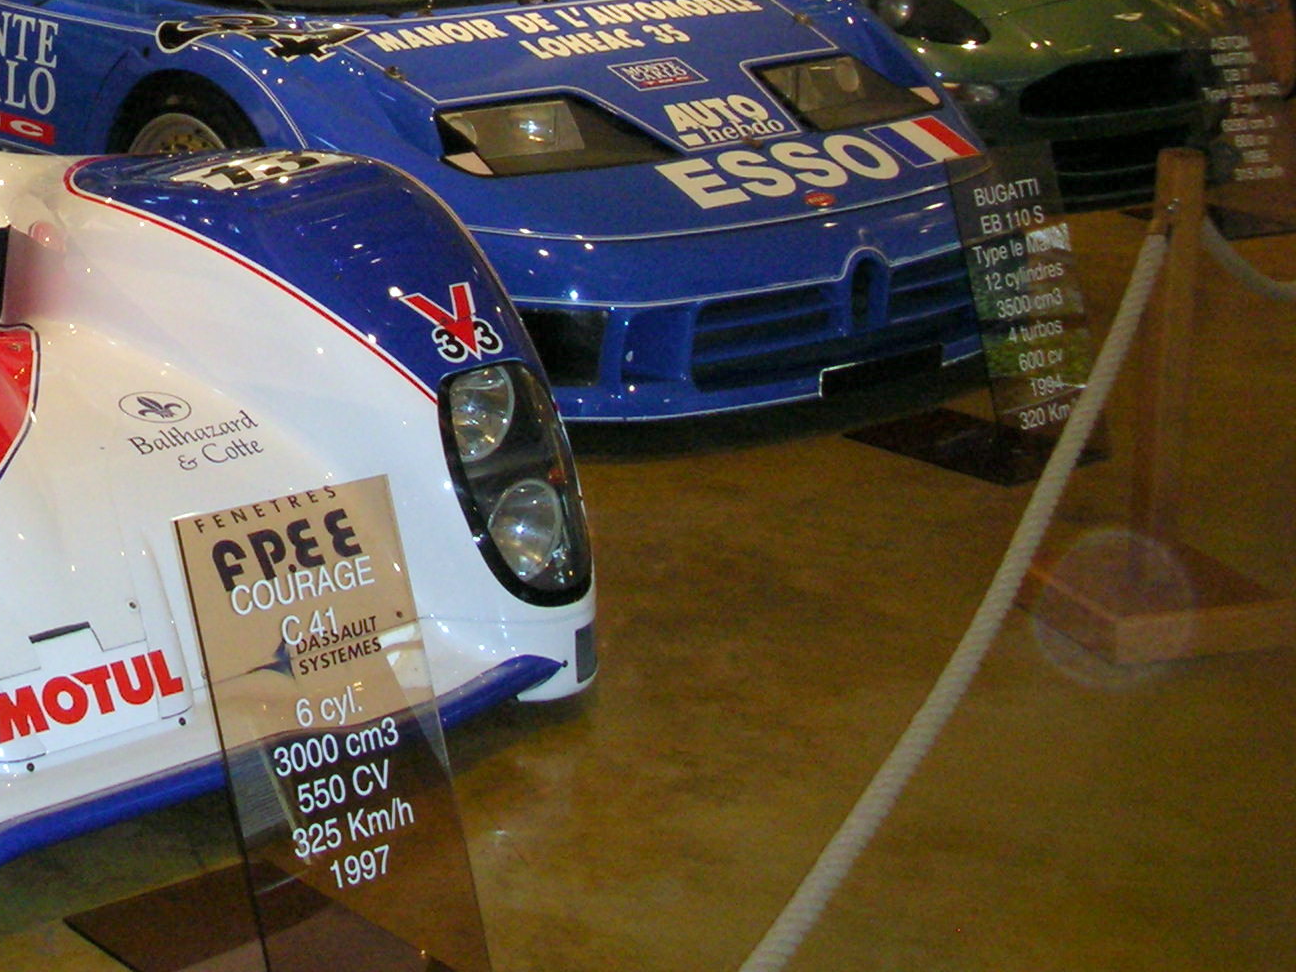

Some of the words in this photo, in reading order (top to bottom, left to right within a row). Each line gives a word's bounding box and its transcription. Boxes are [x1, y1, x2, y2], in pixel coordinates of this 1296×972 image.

[366, 18, 508, 52] MANOIR
[504, 13, 561, 34] DE
[519, 28, 646, 60] LOHEAC
[642, 24, 691, 45] 35
[664, 94, 769, 132] AUTO
[704, 114, 785, 144] hebdo
[654, 134, 900, 209] ESSO
[974, 178, 1041, 207] BUGATTI
[980, 214, 1003, 234] EB
[1005, 208, 1031, 230] 110
[1033, 205, 1045, 224] S
[972, 245, 1008, 268] Type
[1009, 239, 1023, 257] le
[985, 272, 1003, 290] 12
[1005, 262, 1065, 290] cylindres
[996, 294, 1031, 318] 3500
[1034, 287, 1063, 308] cm3
[1020, 319, 1064, 342] turbos
[1018, 350, 1046, 372] 600
[128, 409, 259, 456] Balthazard
[1019, 407, 1046, 430] 320
[1047, 402, 1071, 422] Km
[178, 454, 198, 471] &
[202, 438, 264, 463] Cotte
[194, 485, 337, 534] FENETRES
[230, 556, 375, 615] COURAGE
[281, 615, 303, 646] C
[309, 607, 339, 637] 41
[296, 616, 378, 655] DASSAULT
[299, 637, 382, 676] SYSTEMES
[296, 698, 314, 727] 6
[320, 685, 363, 725] cyl.
[274, 733, 339, 777] 3000
[346, 717, 400, 757] cm3
[297, 774, 346, 814] 550
[352, 759, 389, 796] CV
[292, 817, 342, 858] 325
[347, 797, 415, 841] Km/h
[329, 844, 391, 889] 1997
